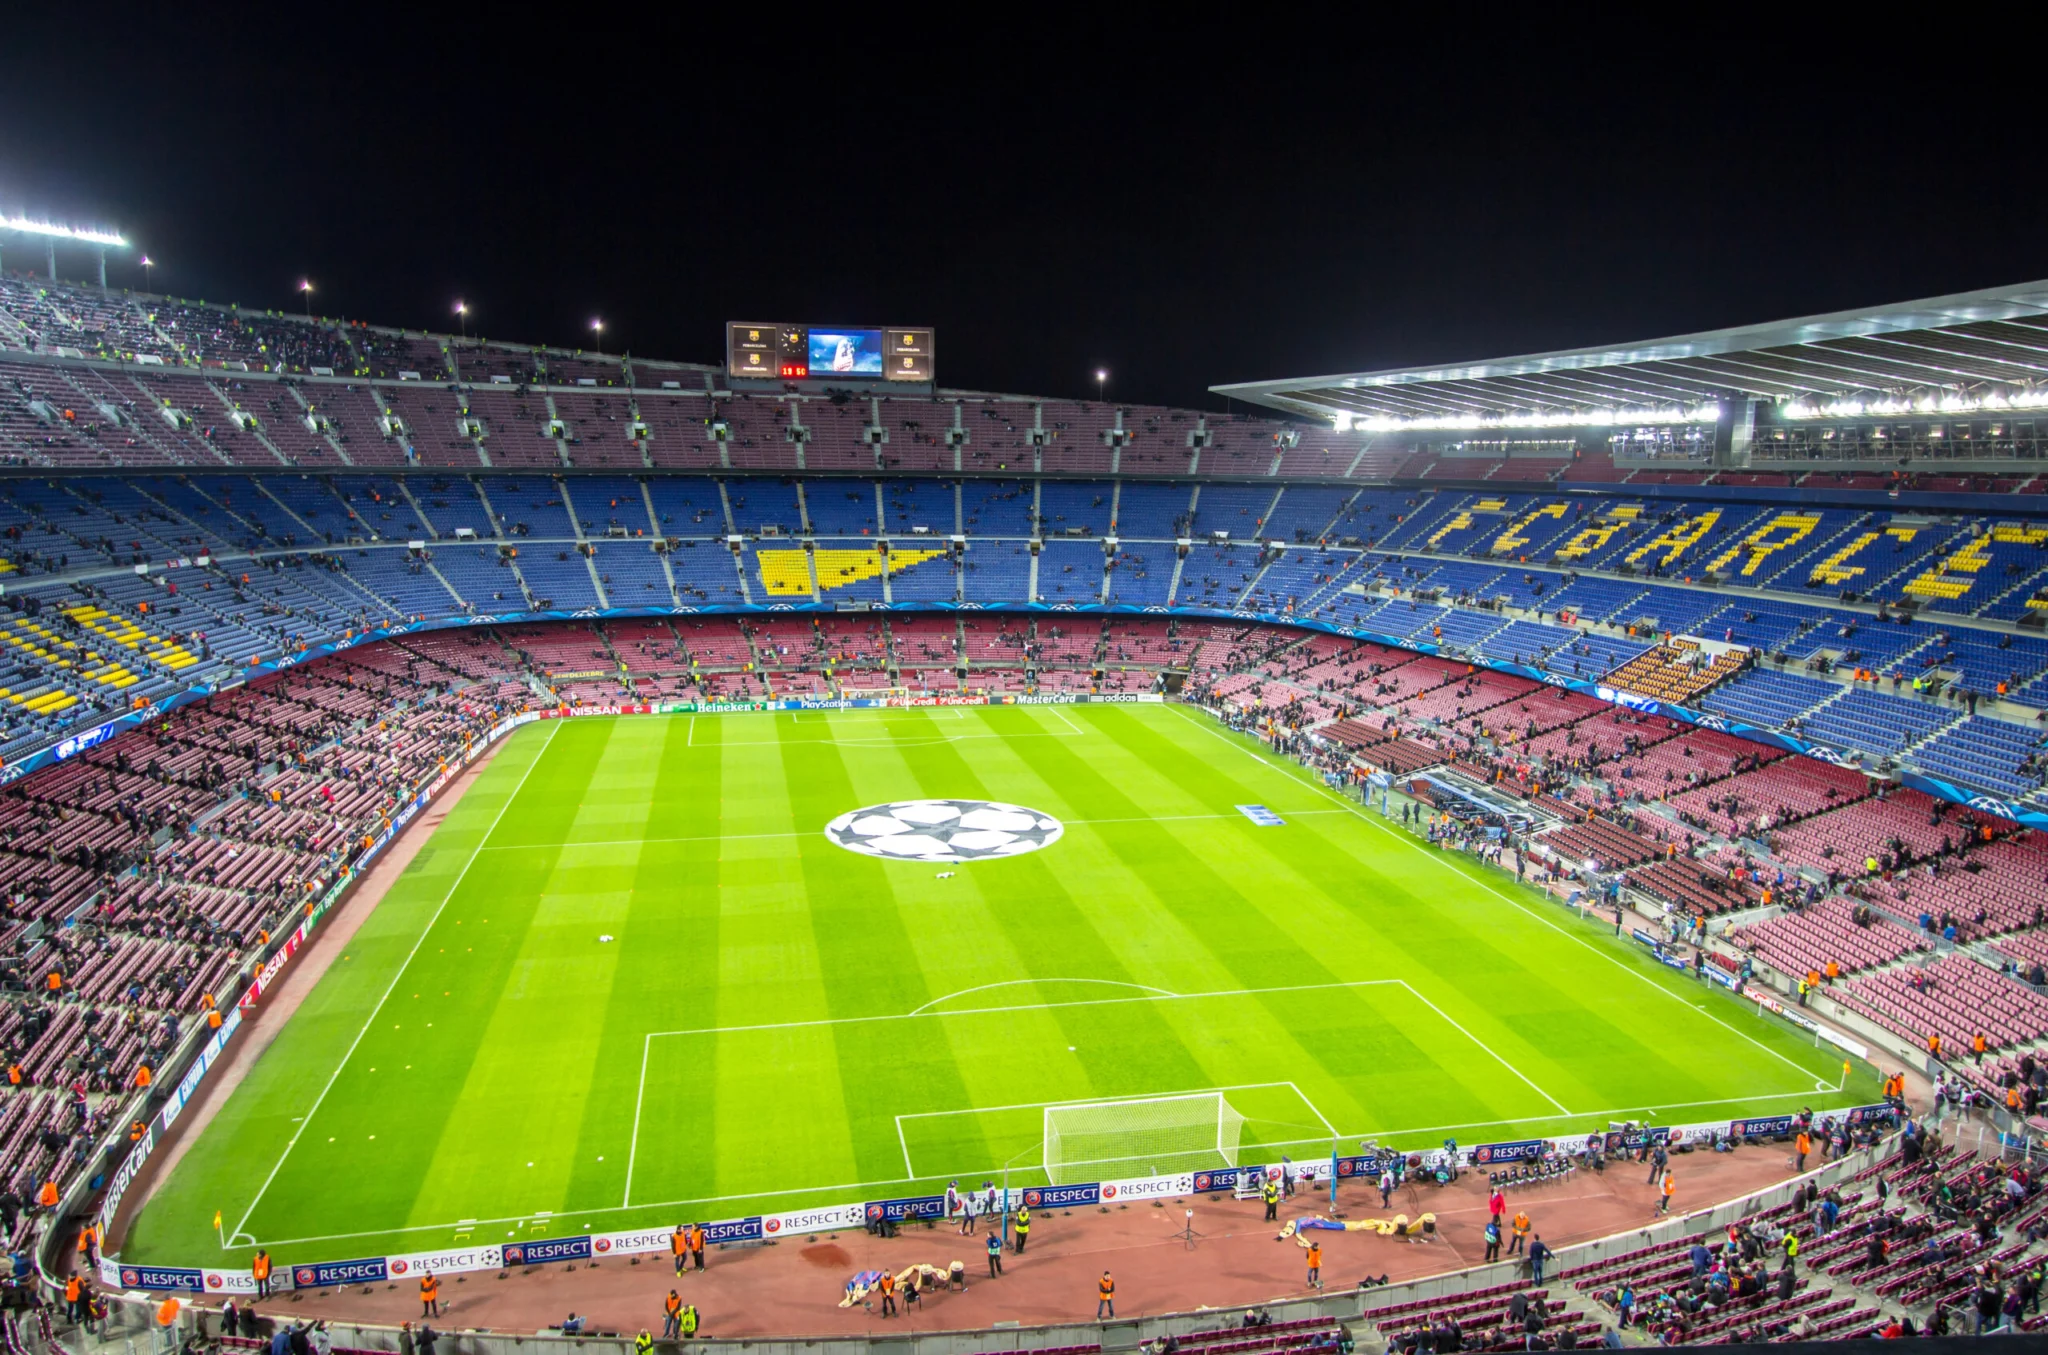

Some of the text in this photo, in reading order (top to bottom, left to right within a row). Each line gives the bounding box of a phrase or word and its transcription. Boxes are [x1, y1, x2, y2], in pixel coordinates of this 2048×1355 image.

[800, 699, 852, 709] PlayStation
[947, 696, 985, 706] UniCredit
[1016, 693, 1076, 705] MasterCard
[1104, 694, 1137, 703] adidas
[569, 705, 622, 717] NISSAN
[697, 702, 751, 713] Heineken
[256, 947, 288, 995] NISSAN
[1782, 1008, 1819, 1031] MasterCard
[1746, 1120, 1790, 1135] RESPECT
[1492, 1144, 1541, 1159] RESPECT
[103, 1128, 154, 1235] MasterCard
[1120, 1180, 1172, 1196] RESPECT
[1044, 1187, 1099, 1202] RESPECT
[886, 1200, 944, 1217] RESPECT
[784, 1211, 842, 1229] RESPECT
[527, 1240, 590, 1258] RESPECT
[412, 1253, 476, 1271] RESPECT
[142, 1272, 201, 1287] RESPECT
[319, 1263, 385, 1281] RESPECT
